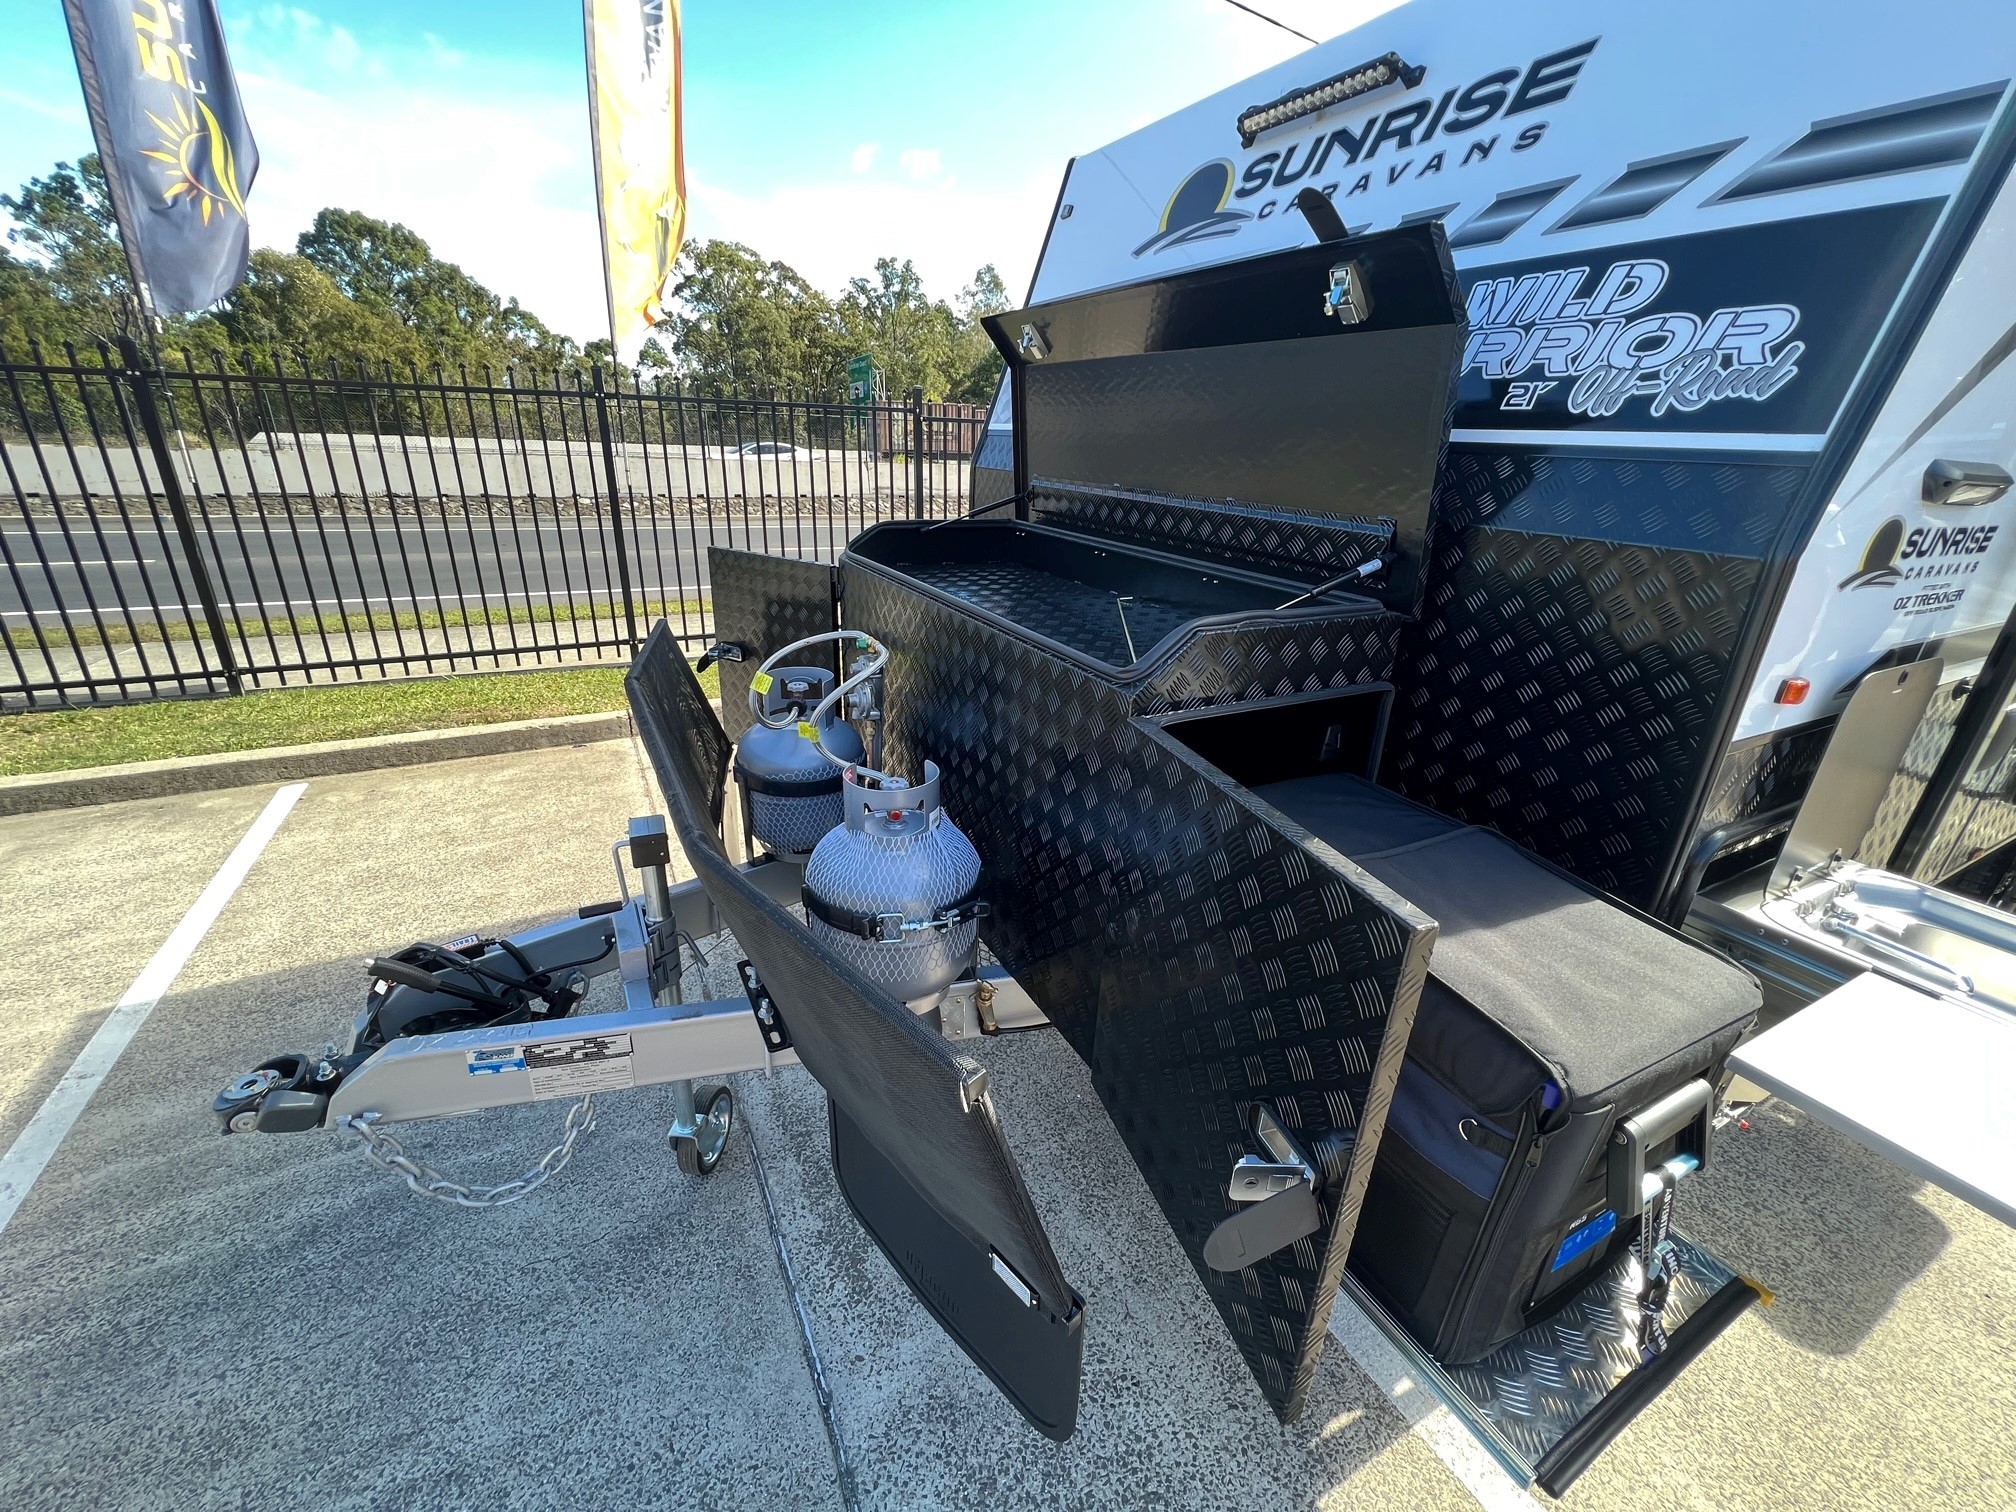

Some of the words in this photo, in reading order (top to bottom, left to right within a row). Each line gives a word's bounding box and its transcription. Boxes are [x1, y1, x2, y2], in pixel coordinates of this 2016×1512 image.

[1234, 35, 1603, 201] SUNRISE
[1466, 258, 1669, 331] WILD
[1460, 304, 1801, 379] RRIOR
[1568, 341, 1805, 418] Off-Road
[1900, 524, 1999, 560] SUNRISE
[1904, 560, 1980, 581] CARAVANS
[1894, 597, 1911, 610] OZ
[1912, 589, 1965, 607] TREKKER
[1657, 1188, 1674, 1243] ADVENTUR
